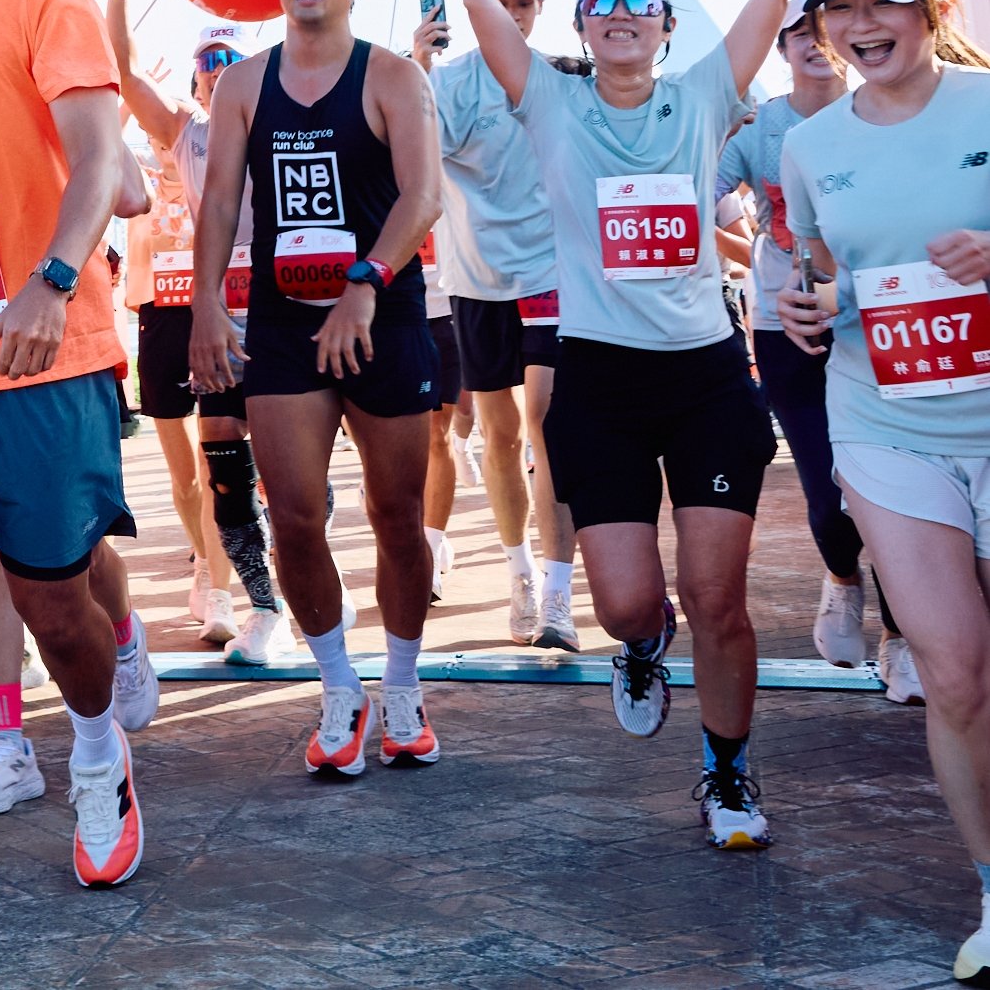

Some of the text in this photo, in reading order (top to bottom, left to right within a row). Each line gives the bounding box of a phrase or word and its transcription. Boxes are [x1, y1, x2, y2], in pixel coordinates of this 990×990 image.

[273, 130, 296, 140] new
[273, 140, 315, 151] run club
[284, 163, 331, 188] NB
[286, 191, 334, 216] RC
[605, 216, 687, 241] 06150
[156, 275, 194, 293] 0127
[280, 262, 345, 285] 00066
[871, 312, 973, 351] 01167
